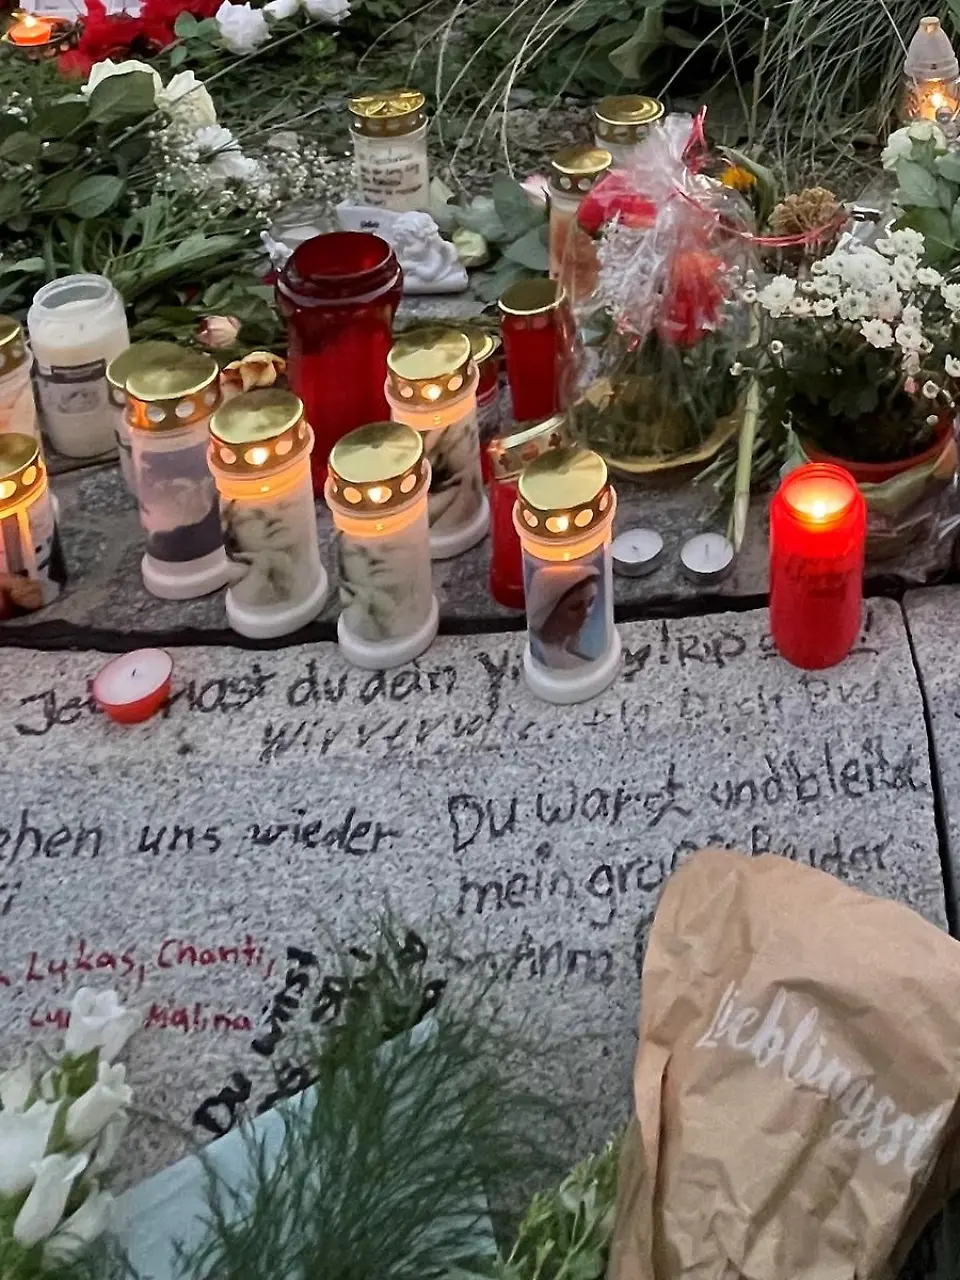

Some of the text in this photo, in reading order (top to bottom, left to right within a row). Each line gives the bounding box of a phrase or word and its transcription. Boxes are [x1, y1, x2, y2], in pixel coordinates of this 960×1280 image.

[286, 659, 350, 707] du
[137, 823, 222, 857] uns
[247, 807, 401, 856] wieder
[447, 793, 519, 854] Du
[456, 840, 578, 916] mein
